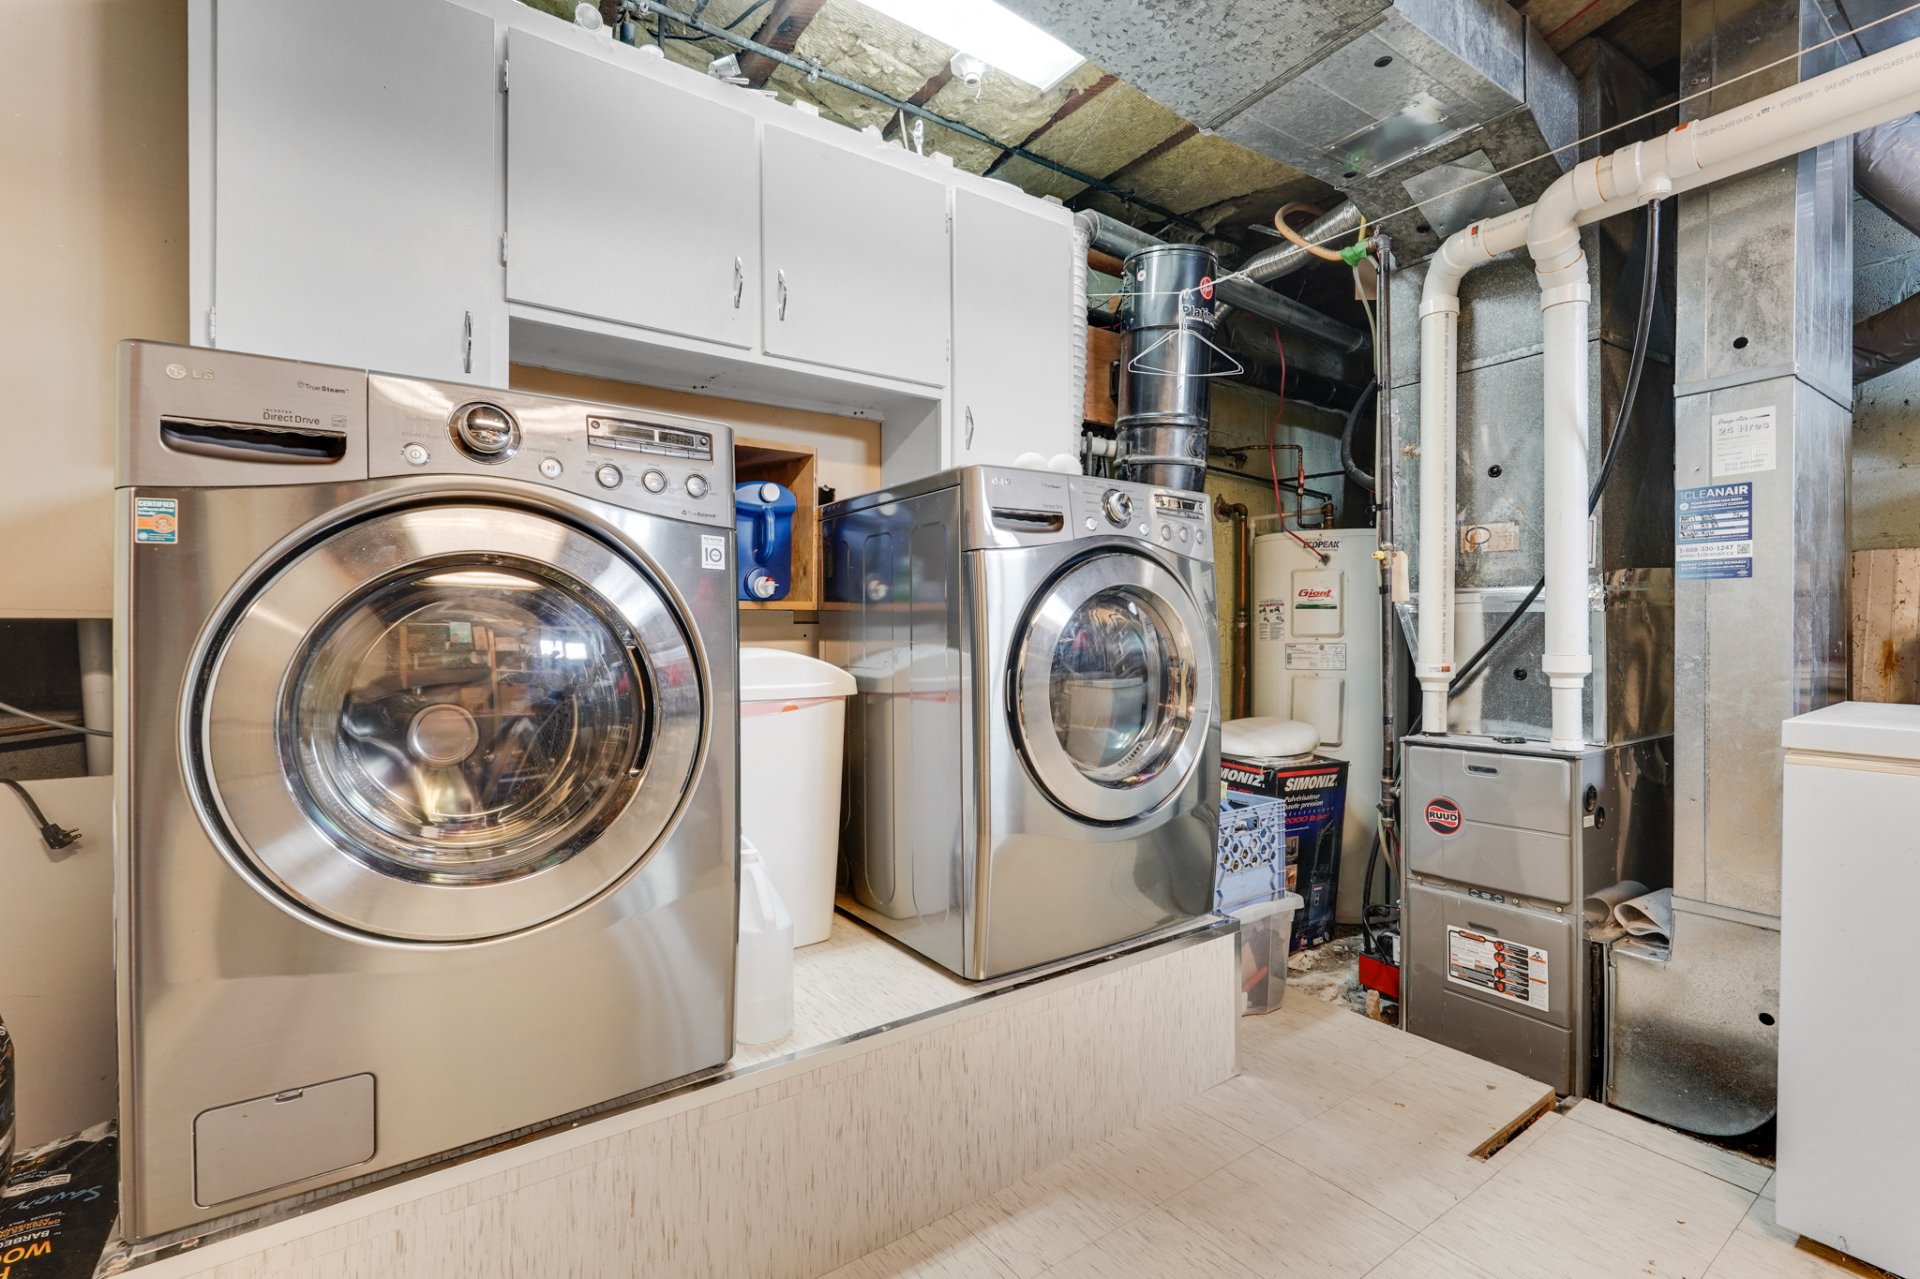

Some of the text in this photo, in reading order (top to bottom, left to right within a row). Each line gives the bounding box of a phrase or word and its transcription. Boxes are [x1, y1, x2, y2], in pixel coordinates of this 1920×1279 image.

[1883, 57, 1904, 70] CLASS
[1680, 485, 1749, 501] 1CLEANAIR
[705, 547, 722, 563] 10
[1298, 588, 1332, 598] Giant
[1221, 767, 1264, 787] MONIZ
[1285, 775, 1337, 792] SIMONIZ
[1301, 801, 1324, 810] pression
[1429, 811, 1458, 821] RUUD
[0, 1240, 52, 1264] WO
